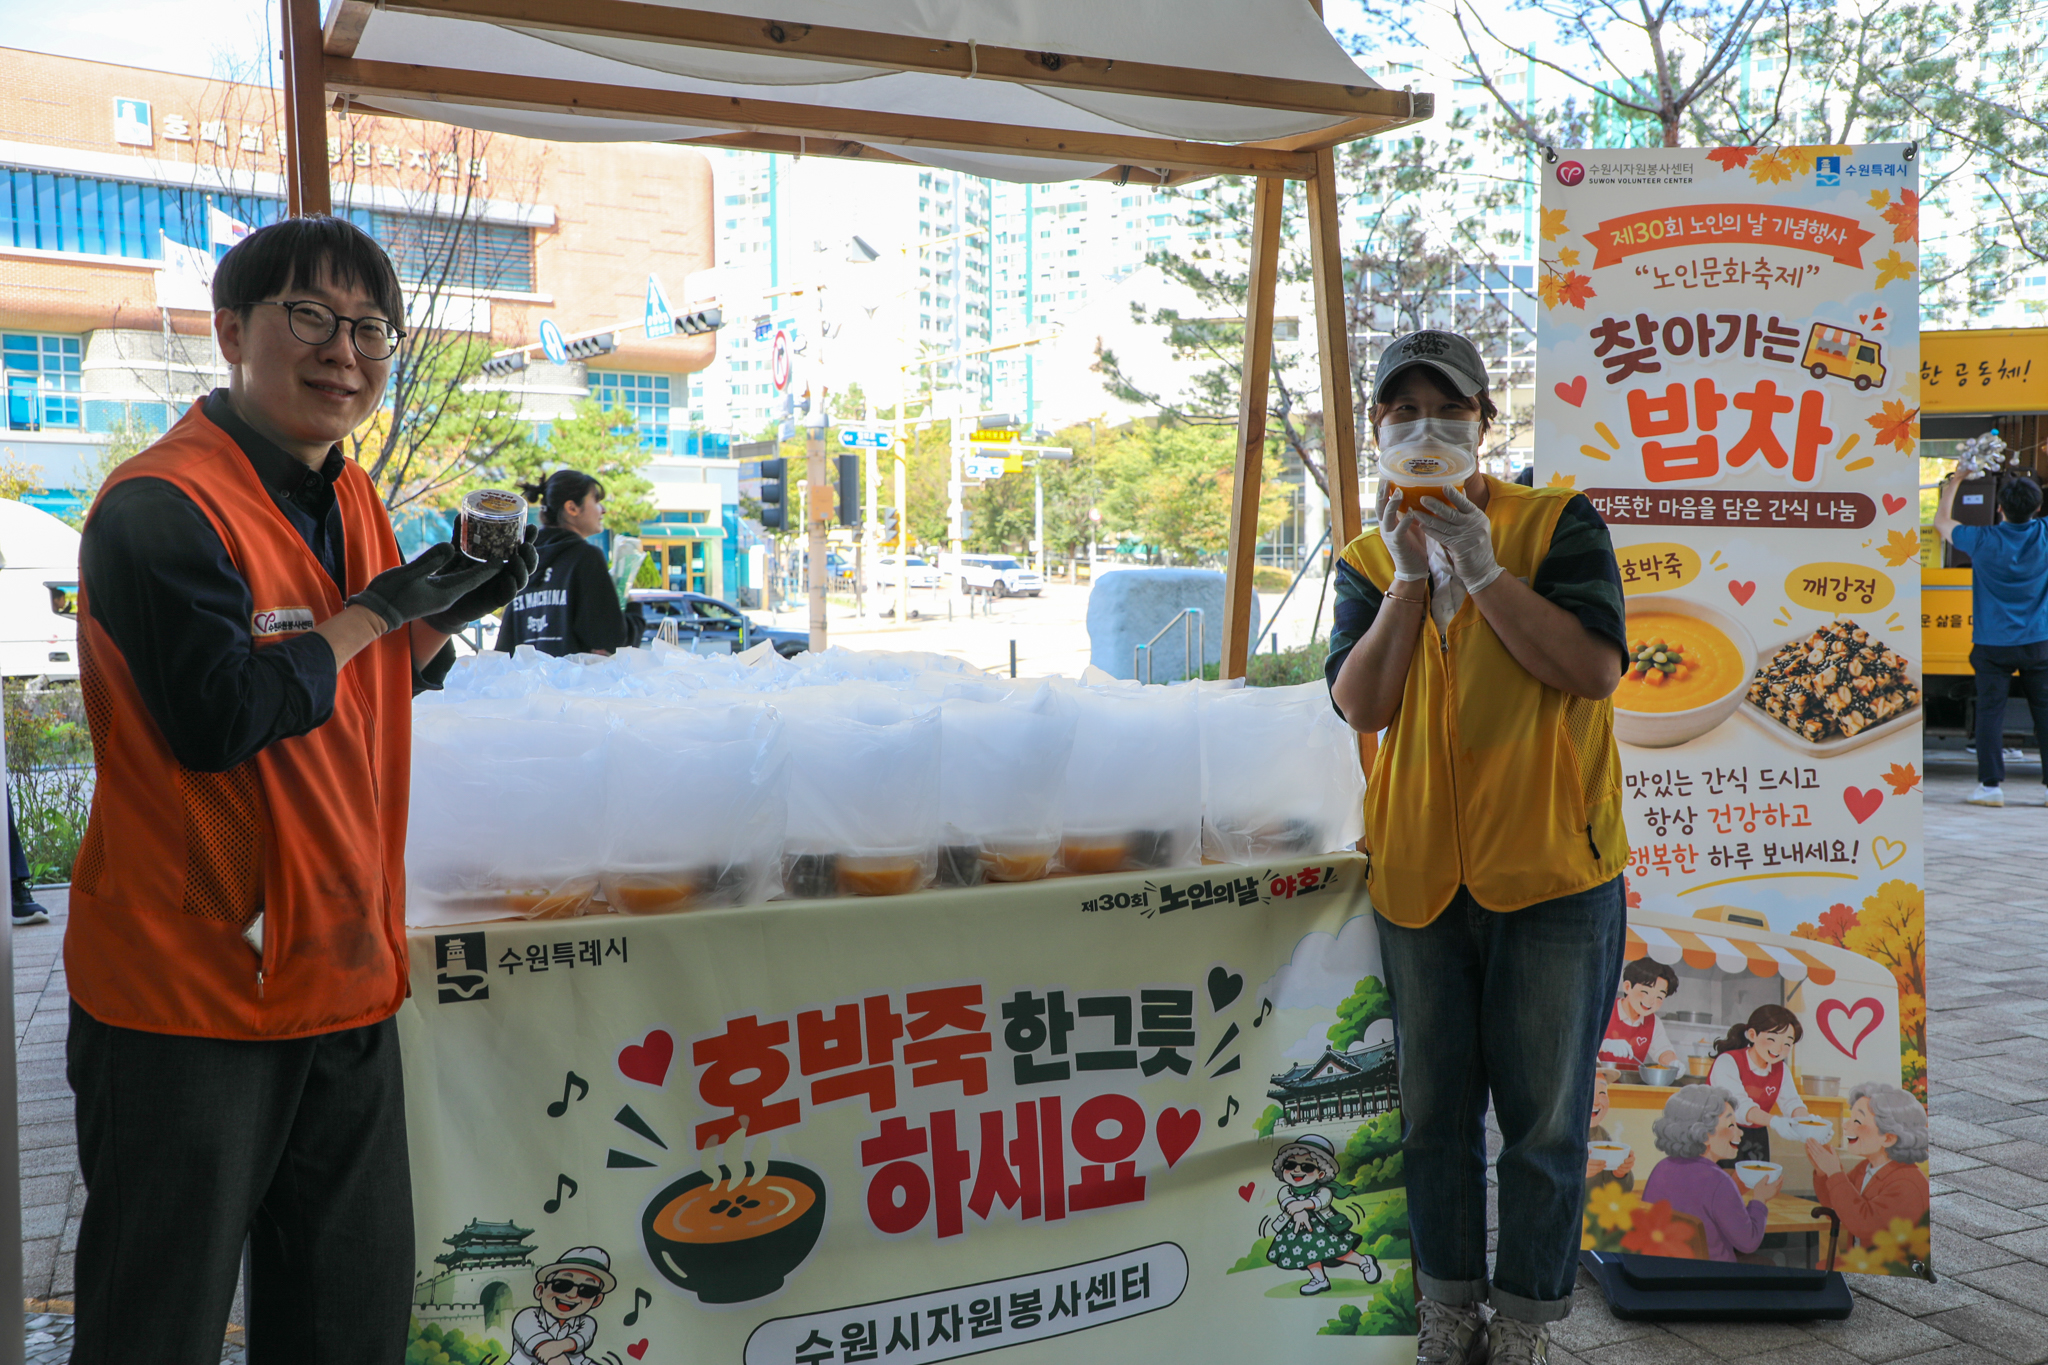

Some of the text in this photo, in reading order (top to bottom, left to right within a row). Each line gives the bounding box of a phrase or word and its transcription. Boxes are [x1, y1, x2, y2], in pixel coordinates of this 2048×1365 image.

[1589, 163, 1694, 176] 수원시자원봉사센터
[1845, 164, 1907, 177] 수원특례시
[1610, 213, 1848, 246] 제30회 노인의 날 기념행사
[1589, 313, 1800, 384] 찾아가는
[1626, 378, 1833, 483] 밥차
[1592, 495, 1857, 522] 따뜻한 마음을 담은 간식 나눔
[1618, 552, 1683, 583] 호박죽
[1802, 576, 1876, 604] 깨강정
[1626, 767, 1820, 799] 맛있는 간식 드시고
[1644, 802, 1812, 837] 항상 건강하고
[1626, 839, 1859, 877] 행복한 하루 보내세요!
[1081, 891, 1149, 913] 제30회
[1270, 866, 1335, 899] 야호!
[498, 936, 628, 975] 수원특례시
[692, 984, 1196, 1151] 호박죽 한그릇
[860, 1093, 1147, 1240] 하세요
[795, 1262, 1151, 1365] 수원시자원봉사센터
